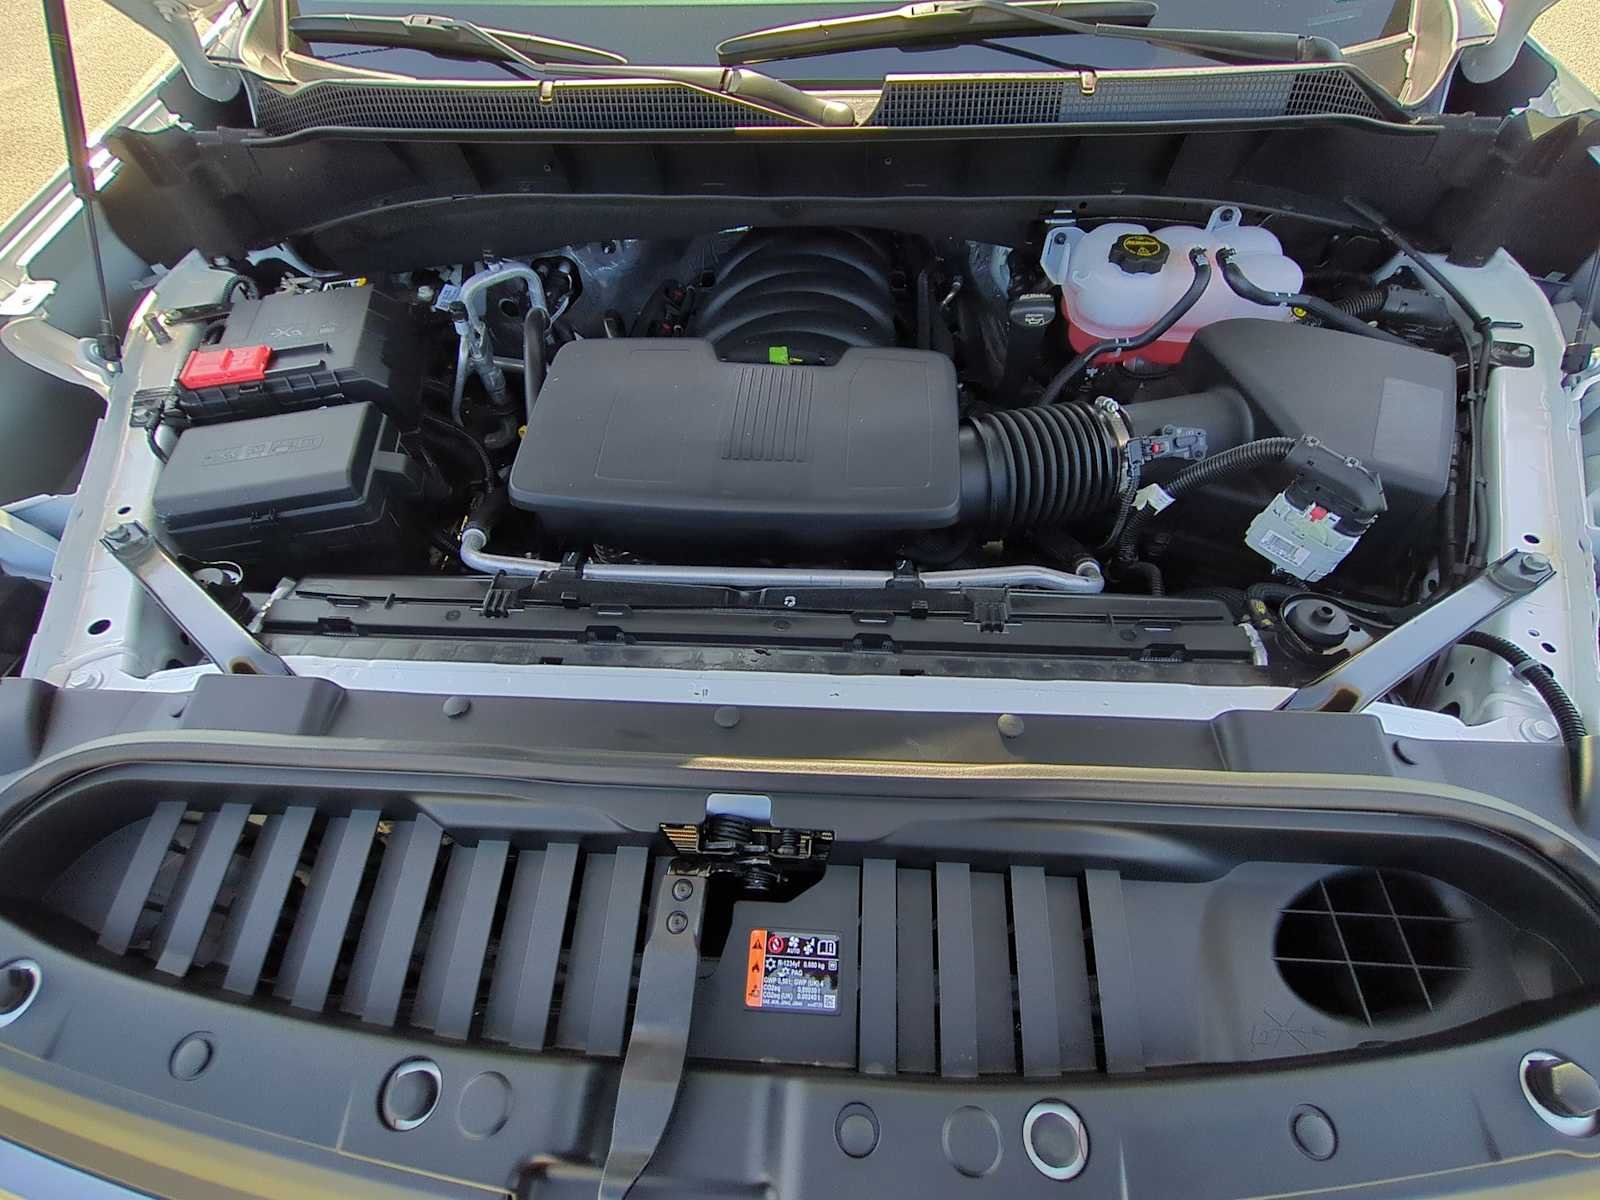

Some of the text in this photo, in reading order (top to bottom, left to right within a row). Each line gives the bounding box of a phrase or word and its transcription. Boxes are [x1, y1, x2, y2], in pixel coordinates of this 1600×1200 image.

[818, 961, 826, 970] kg
[763, 976, 777, 984] GWP
[794, 978, 807, 986] GWP
